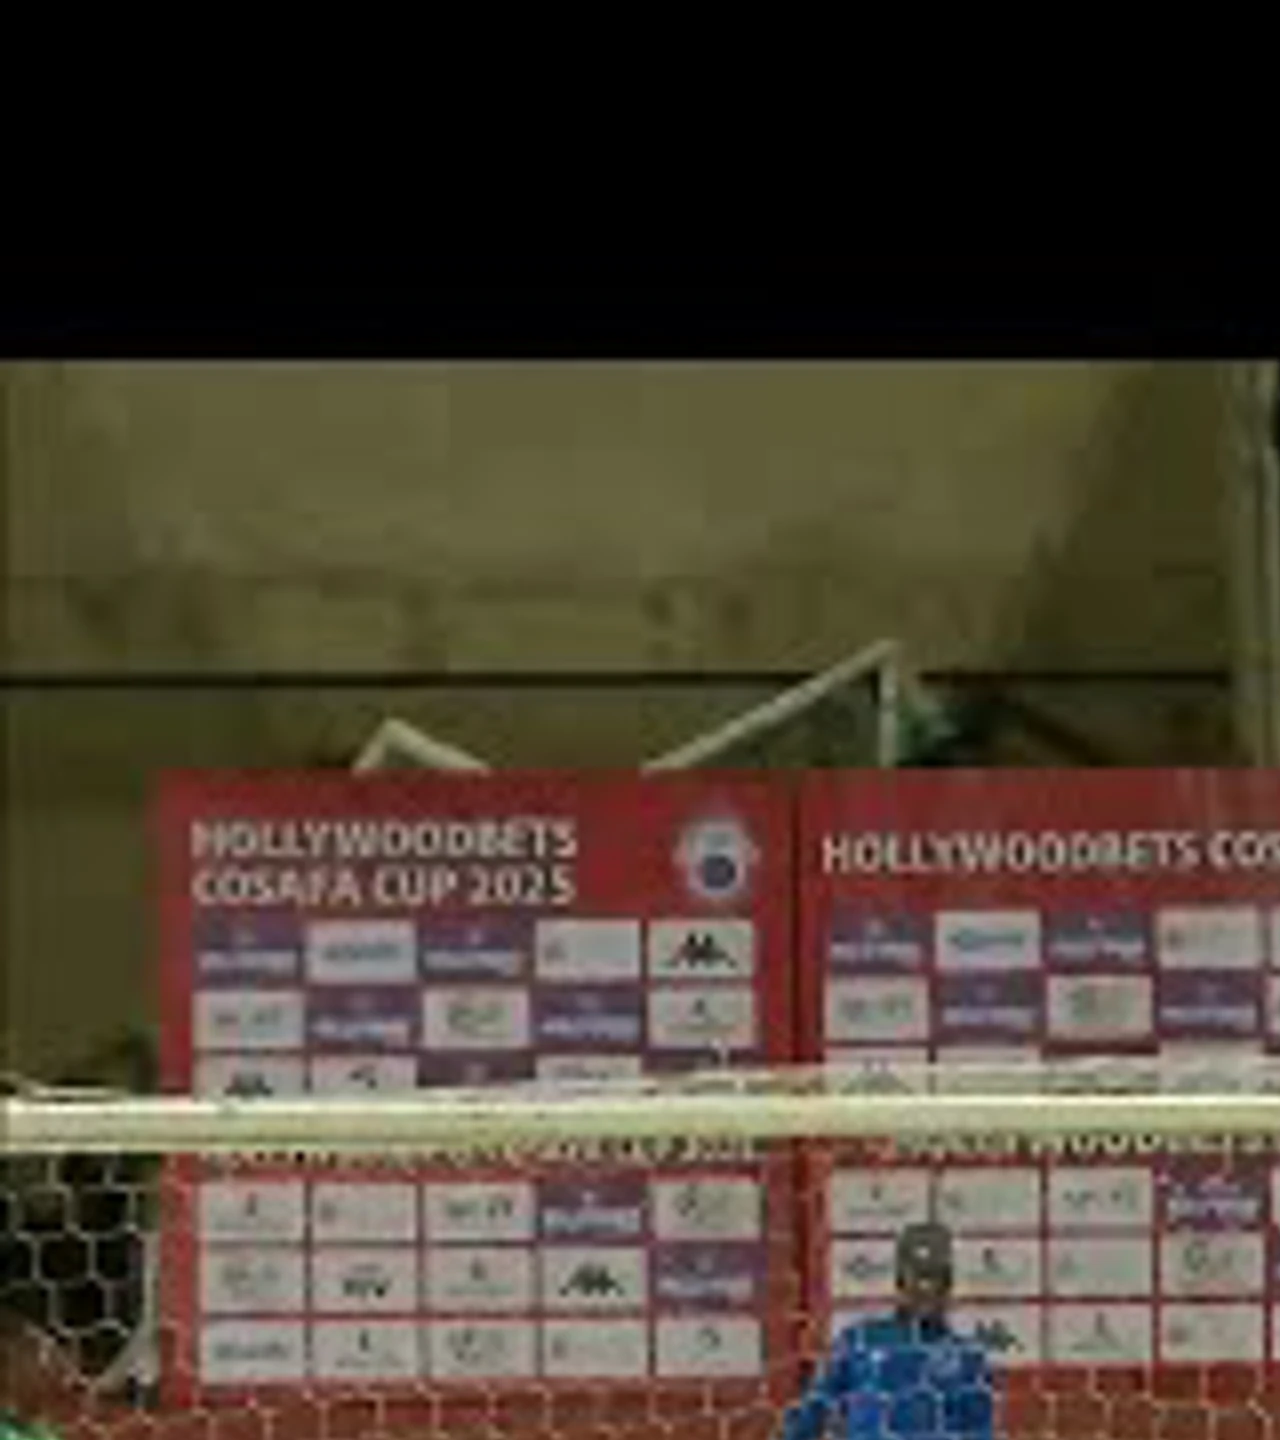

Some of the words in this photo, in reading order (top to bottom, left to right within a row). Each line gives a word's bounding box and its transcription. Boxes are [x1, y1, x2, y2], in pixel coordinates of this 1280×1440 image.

[190, 820, 578, 859] HOLLYWOODBETS
[823, 829, 1200, 873] HOLLYWOODBETS
[190, 865, 362, 906] COSAFA
[374, 865, 458, 904] CUP
[470, 865, 577, 905] 2025
